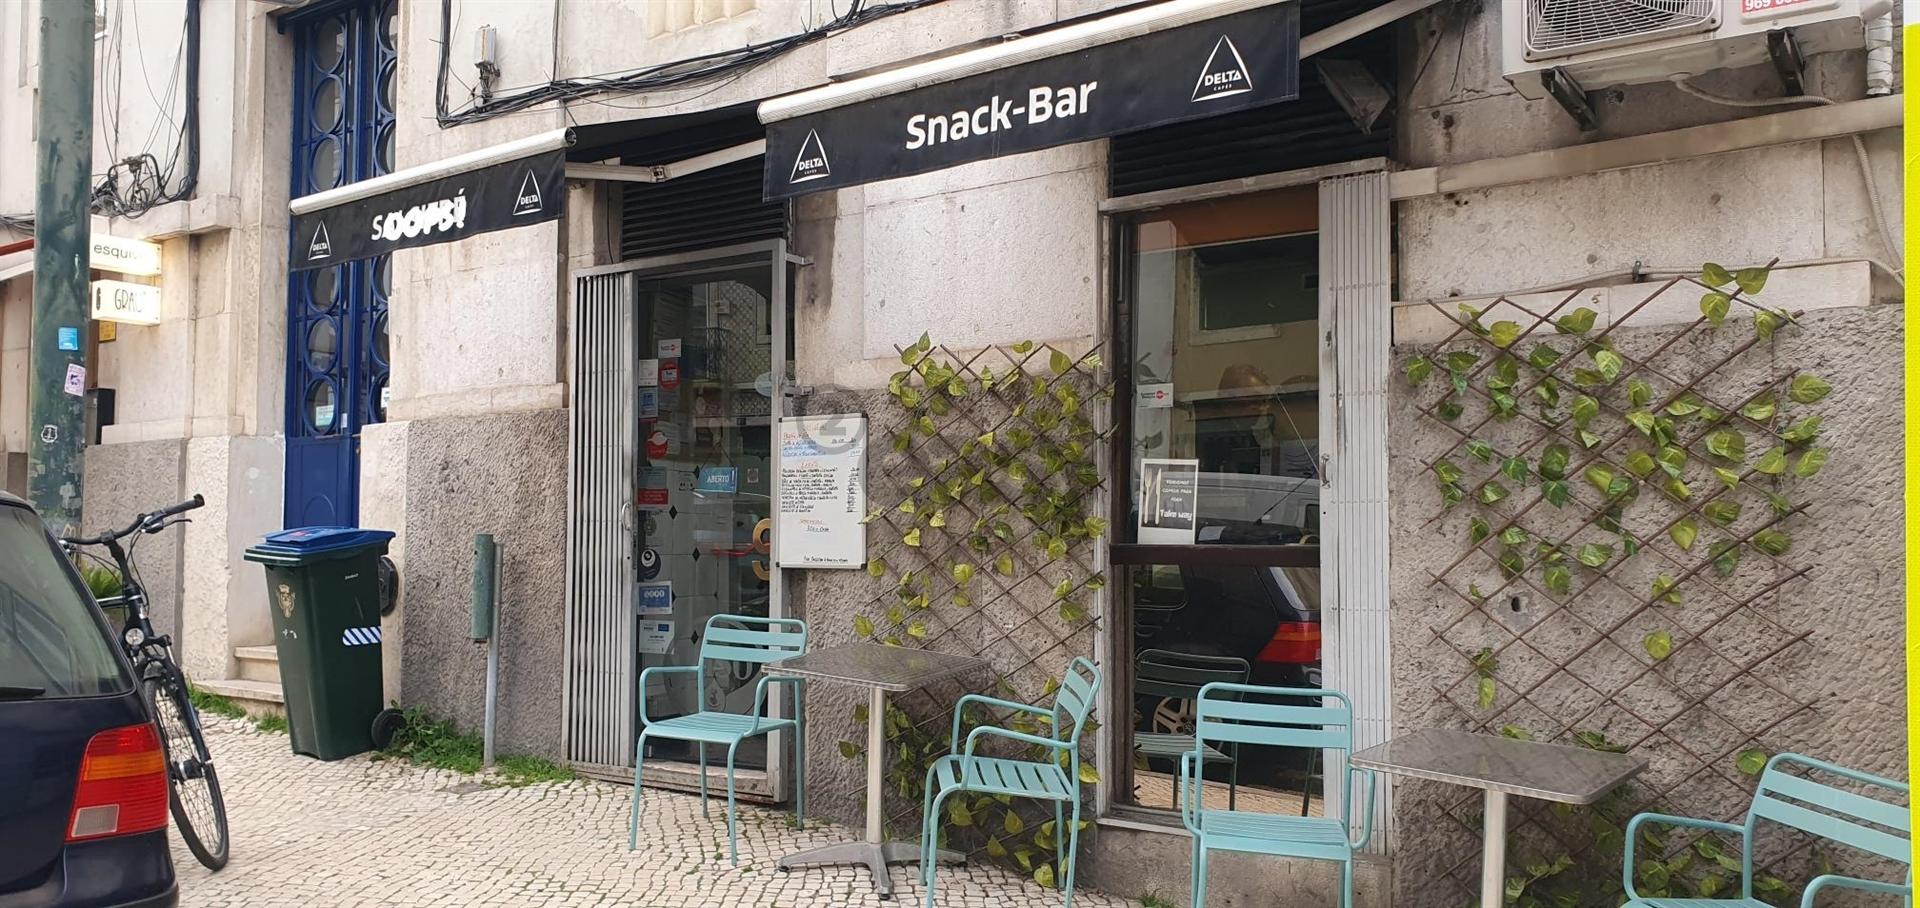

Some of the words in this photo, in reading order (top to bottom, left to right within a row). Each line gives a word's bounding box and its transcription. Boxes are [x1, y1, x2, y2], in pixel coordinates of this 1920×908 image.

[1204, 70, 1242, 86] DELTA
[905, 81, 1098, 150] Snack-Bar
[798, 158, 823, 171] DELTA
[520, 194, 539, 205] DELTA
